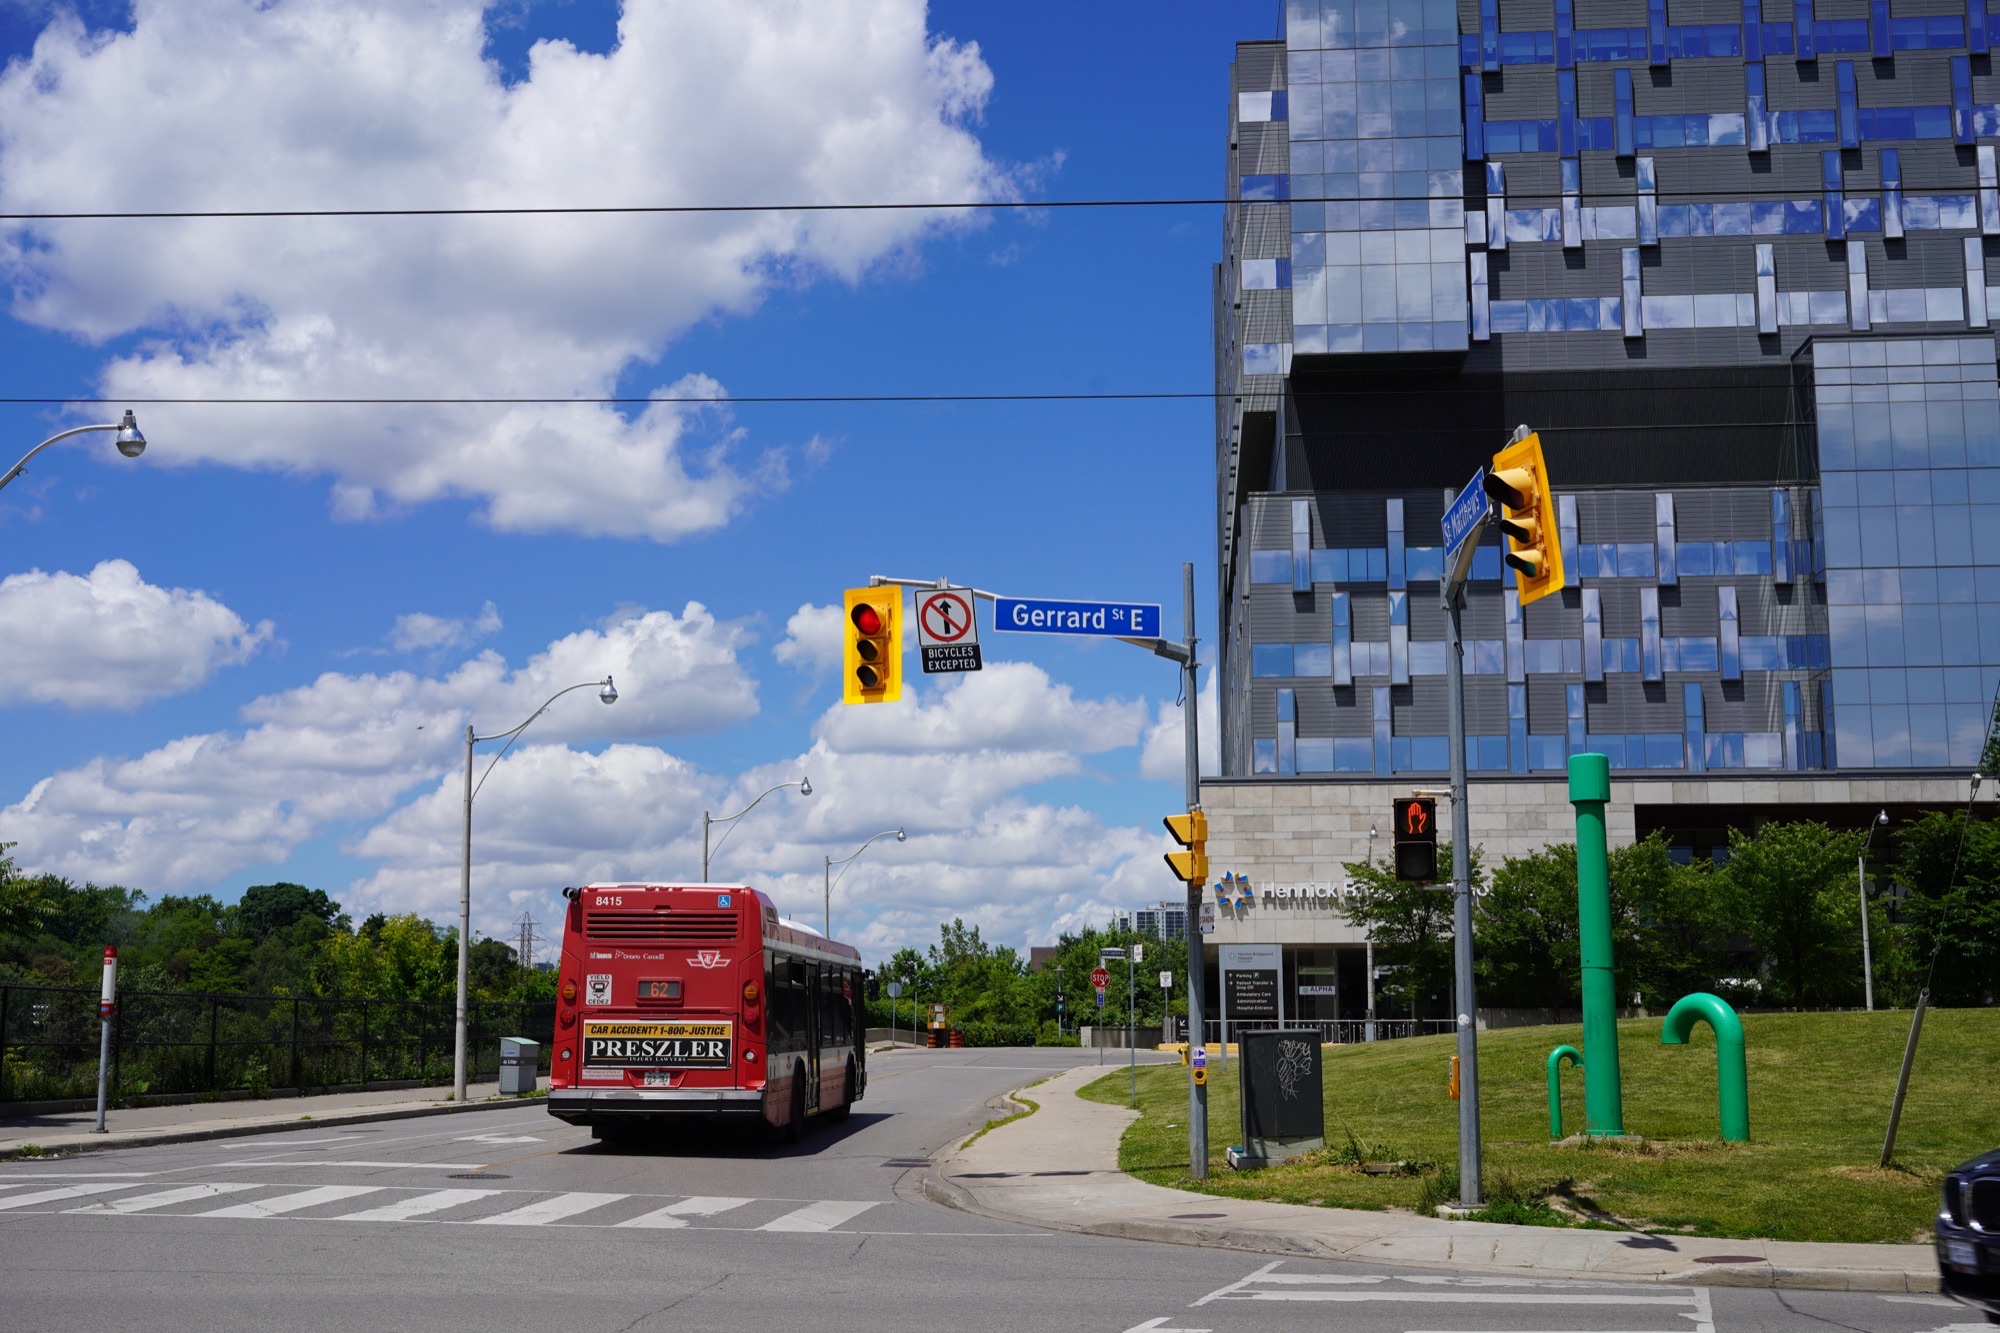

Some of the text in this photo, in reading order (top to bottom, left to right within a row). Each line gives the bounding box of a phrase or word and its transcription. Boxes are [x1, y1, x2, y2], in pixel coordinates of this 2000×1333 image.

[1450, 490, 1480, 539] Matthews
[1012, 603, 1144, 631] Gerrard St E
[927, 646, 974, 659] BICYCLES
[927, 658, 977, 671] EXCEPTED
[1261, 881, 1337, 898] Hennick
[595, 896, 623, 906] 8415
[1204, 906, 1210, 914] NO
[1092, 973, 1109, 982] STOP
[650, 982, 669, 997] 62
[590, 1025, 726, 1036] CAR ACCIDENT? 1-800-JUSTICE
[590, 1040, 726, 1058] PRESZLER
